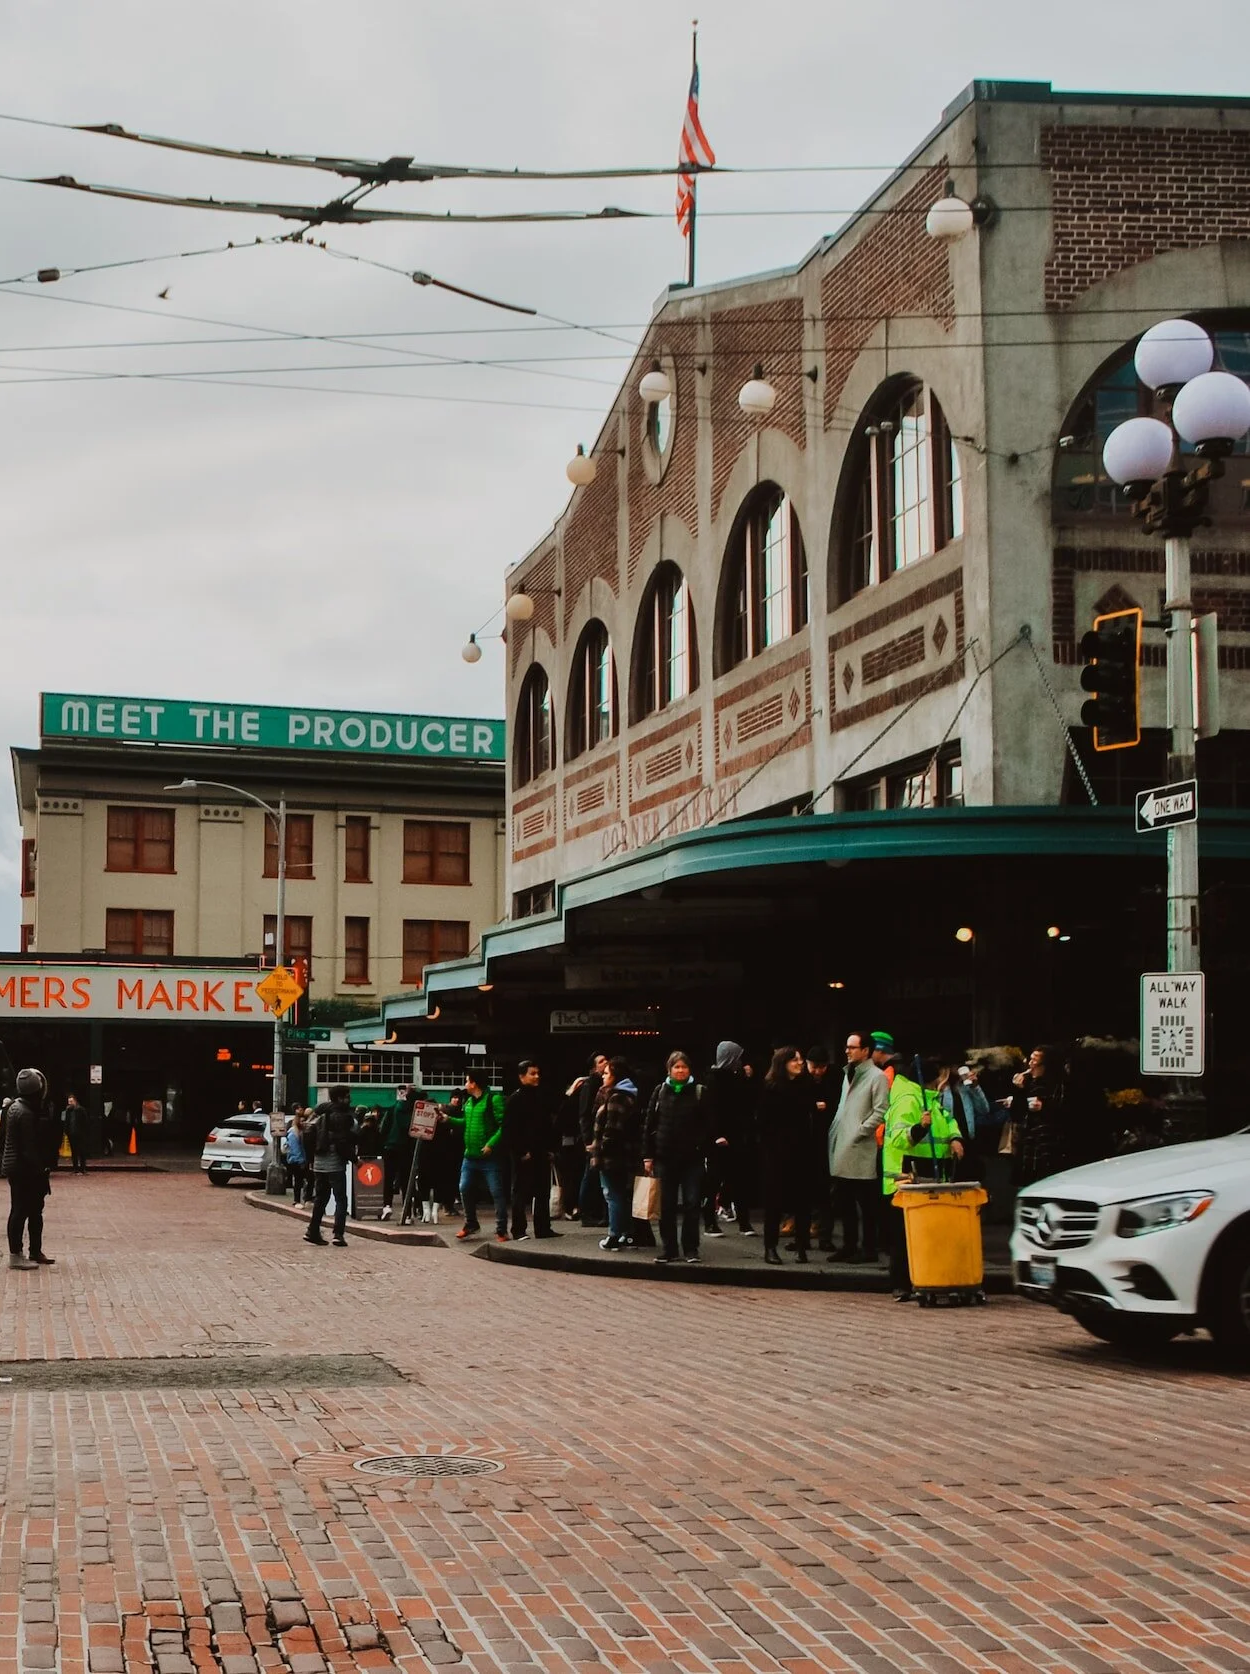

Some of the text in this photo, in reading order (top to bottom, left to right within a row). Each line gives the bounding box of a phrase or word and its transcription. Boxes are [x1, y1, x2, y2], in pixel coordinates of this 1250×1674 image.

[61, 701, 496, 754] MEET THE PRODUCER
[602, 779, 741, 857] CORNER MARKET
[1154, 794, 1190, 816] ONE WAY
[117, 979, 271, 1015] MARKE
[1149, 981, 1196, 993] ALL WAY
[1158, 997, 1187, 1008] WALK
